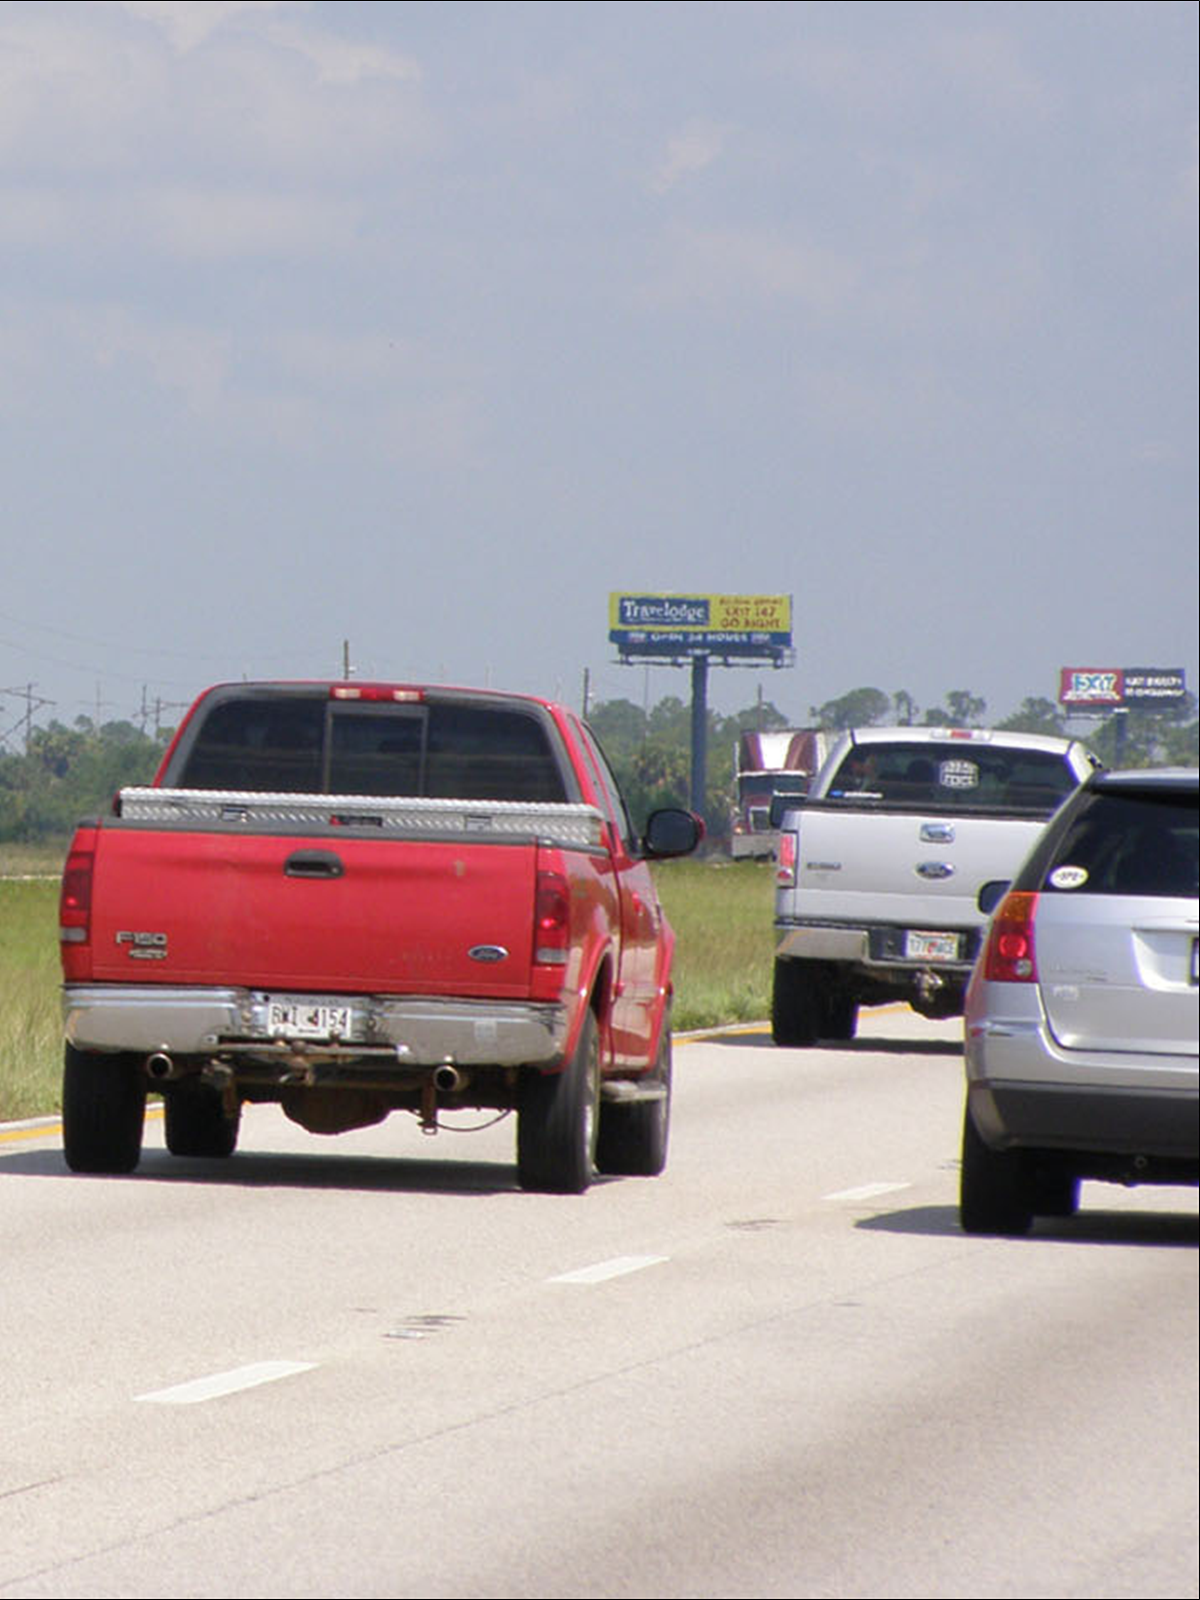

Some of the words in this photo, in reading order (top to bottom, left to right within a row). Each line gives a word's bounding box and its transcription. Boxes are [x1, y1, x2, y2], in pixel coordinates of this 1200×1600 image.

[623, 601, 705, 622] Travelodge
[721, 617, 740, 628] GO
[744, 618, 781, 629] RIGHT
[1073, 673, 1116, 691] EXIT
